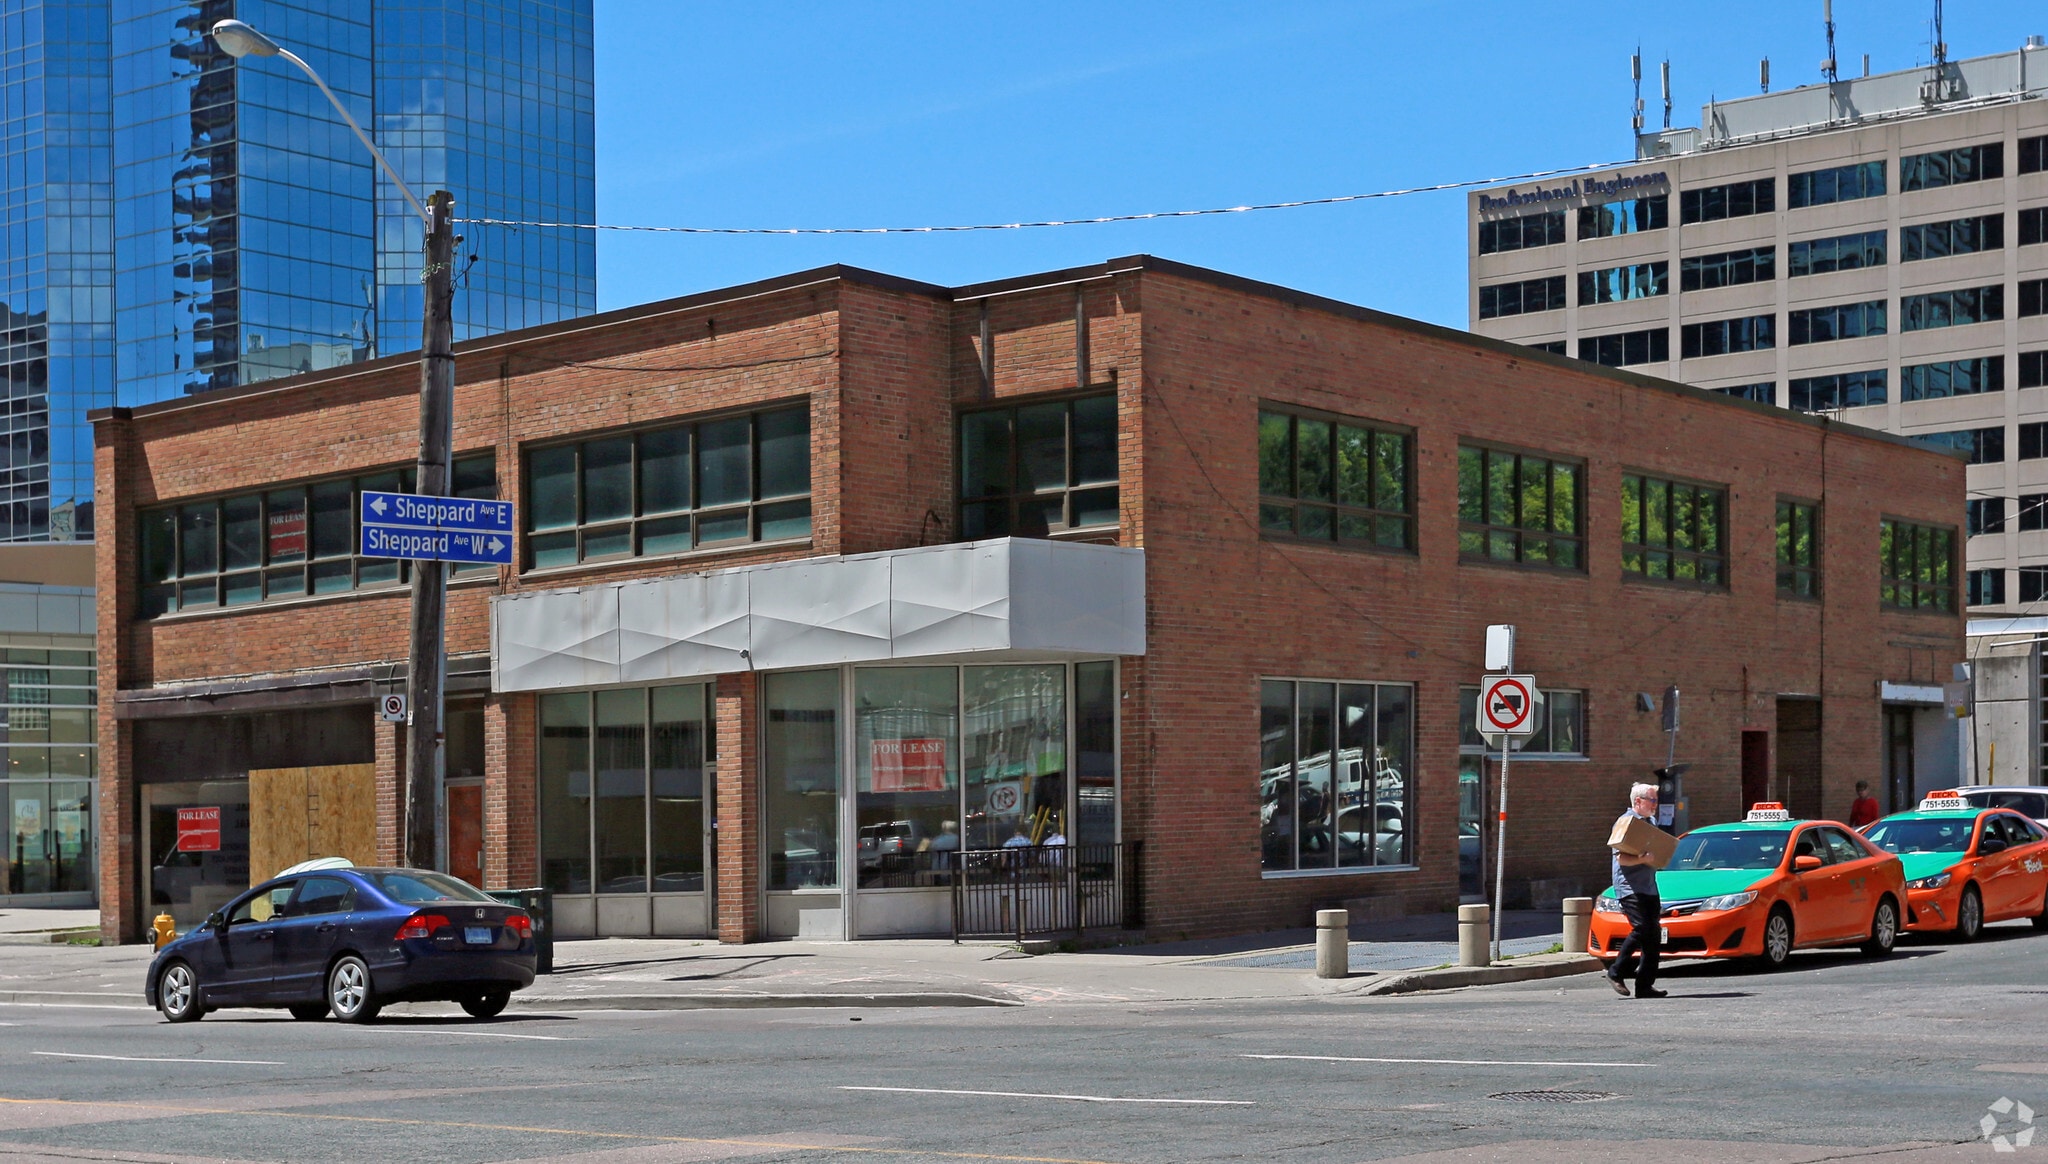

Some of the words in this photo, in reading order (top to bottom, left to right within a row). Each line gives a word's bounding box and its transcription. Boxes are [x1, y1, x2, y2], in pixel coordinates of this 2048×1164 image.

[1478, 179, 1578, 212] Professional
[1583, 171, 1667, 197] Engineers
[395, 497, 475, 525] Sheppard
[480, 504, 495, 515] Ave
[497, 504, 507, 524] E
[270, 515, 284, 525] FOR
[368, 528, 449, 556] Sheppard
[453, 534, 469, 546] Ave
[471, 535, 485, 555] W
[873, 743, 900, 754] FOR
[902, 742, 943, 754] LEASE
[1925, 799, 1960, 808] 751-5555
[179, 811, 194, 821] FOR
[195, 810, 218, 820] LEASE
[1750, 811, 1781, 820] 751-5555
